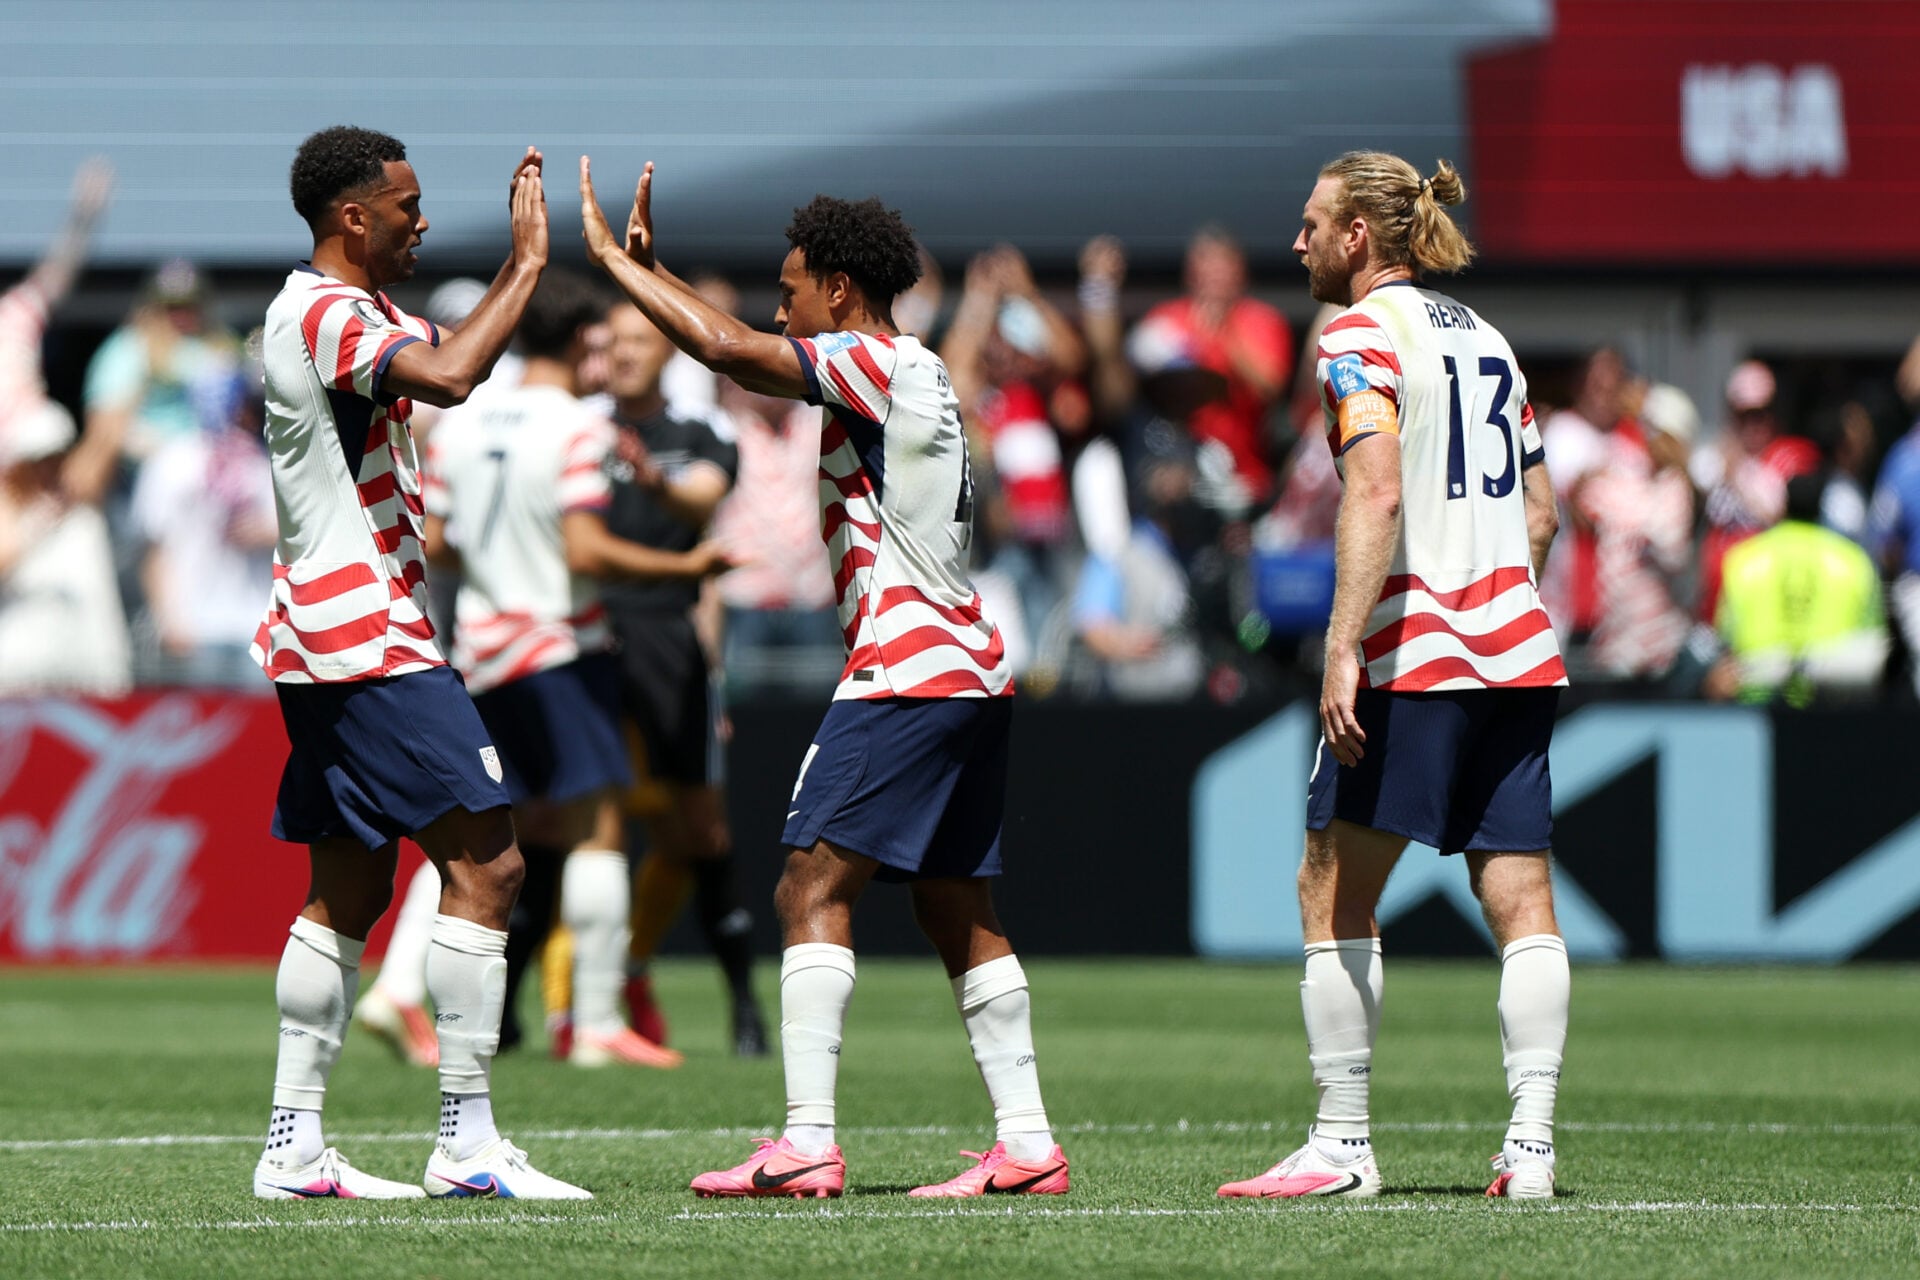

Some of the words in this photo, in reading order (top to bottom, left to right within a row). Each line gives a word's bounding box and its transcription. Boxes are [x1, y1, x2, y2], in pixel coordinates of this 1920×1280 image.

[1680, 64, 1847, 177] USA
[1424, 302, 1477, 330] REAM
[1348, 401, 1387, 416] UNITES
[1442, 355, 1516, 500] 13
[477, 450, 507, 553] 7
